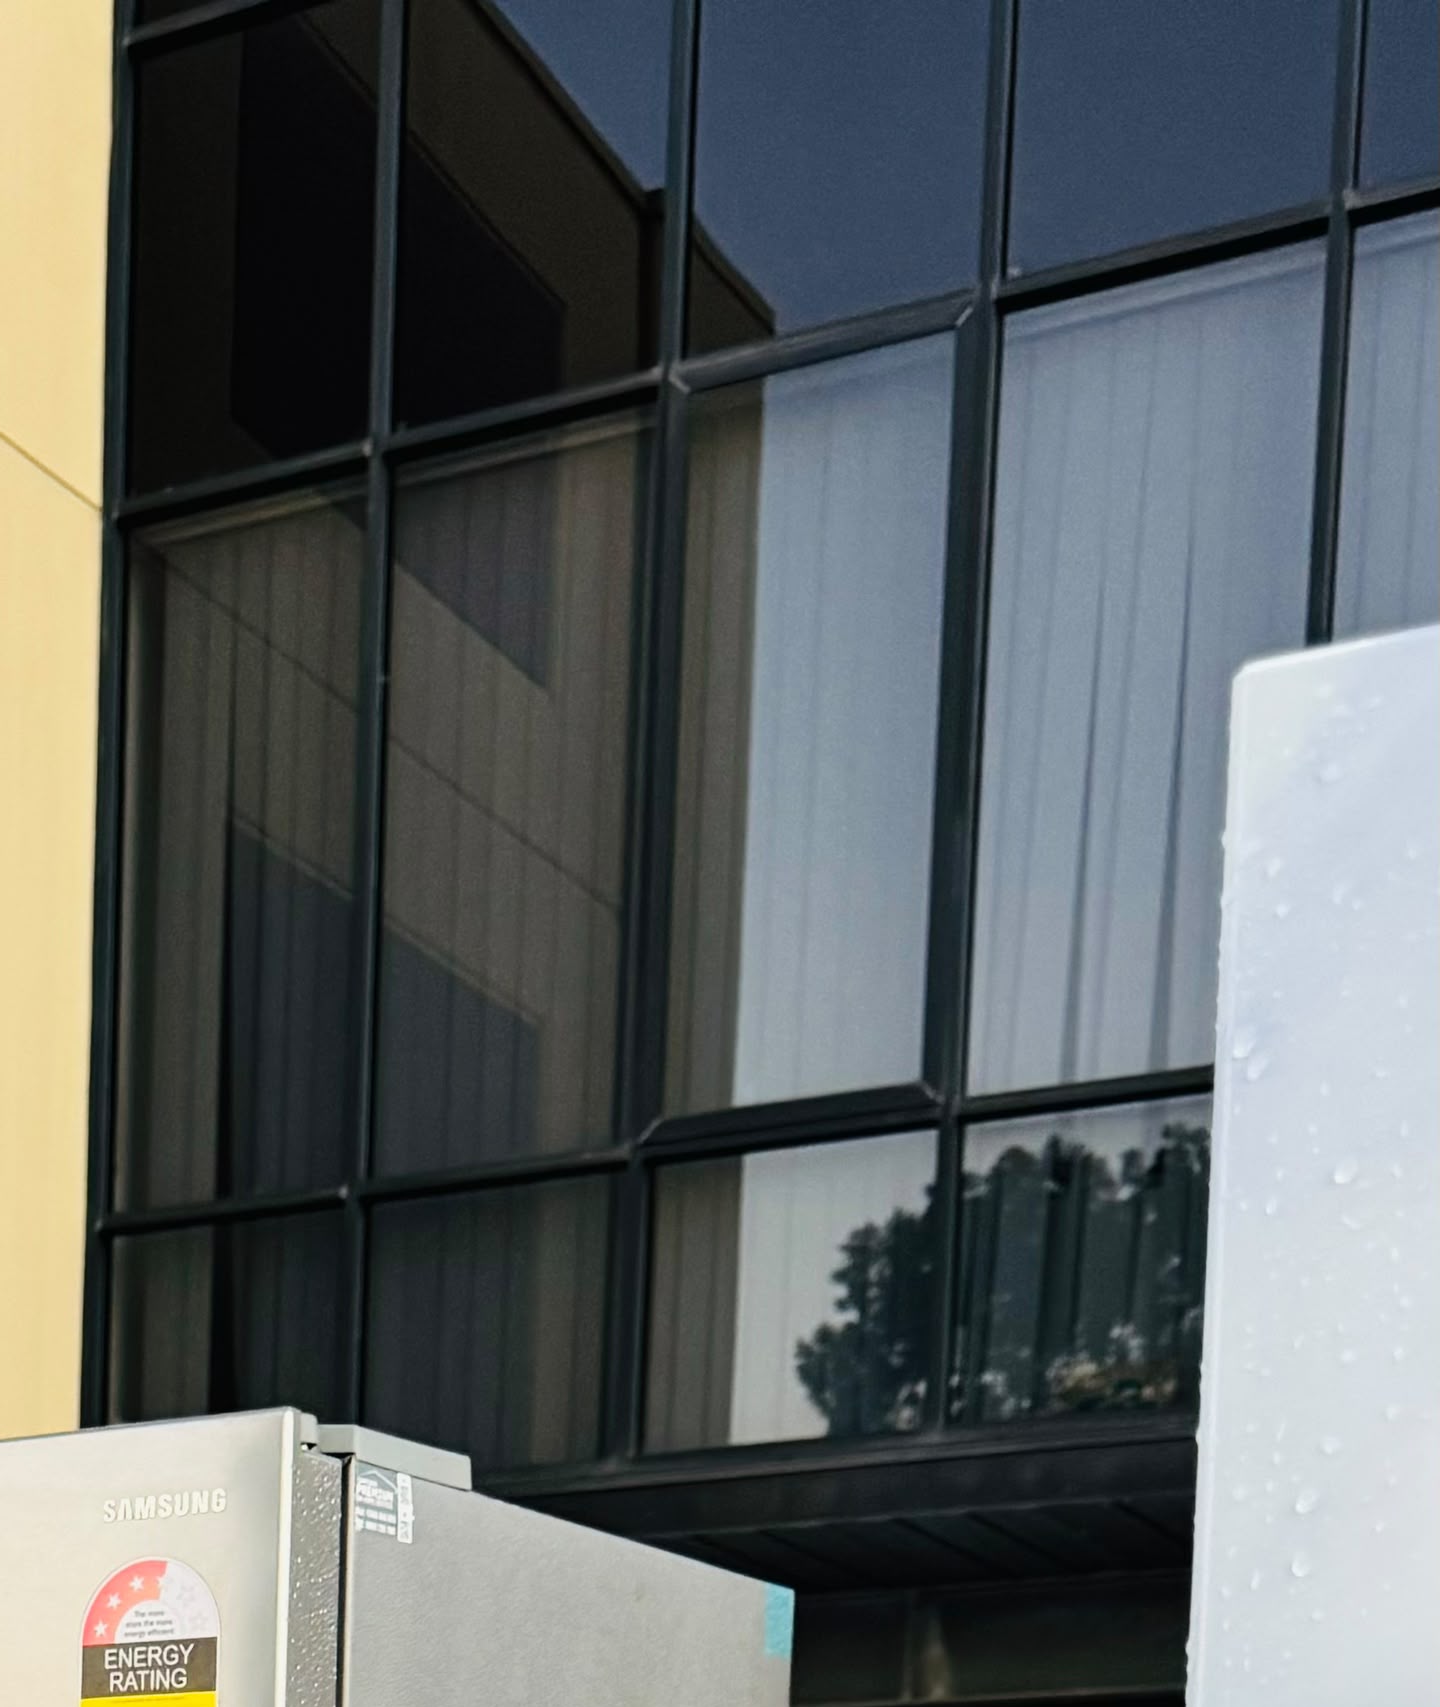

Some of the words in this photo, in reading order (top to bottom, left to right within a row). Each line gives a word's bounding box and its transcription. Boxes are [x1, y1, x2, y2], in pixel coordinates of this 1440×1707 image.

[103, 1488, 227, 1523] SAMSUNG
[104, 1643, 195, 1669] ENERGY
[109, 1667, 188, 1693] RATING
